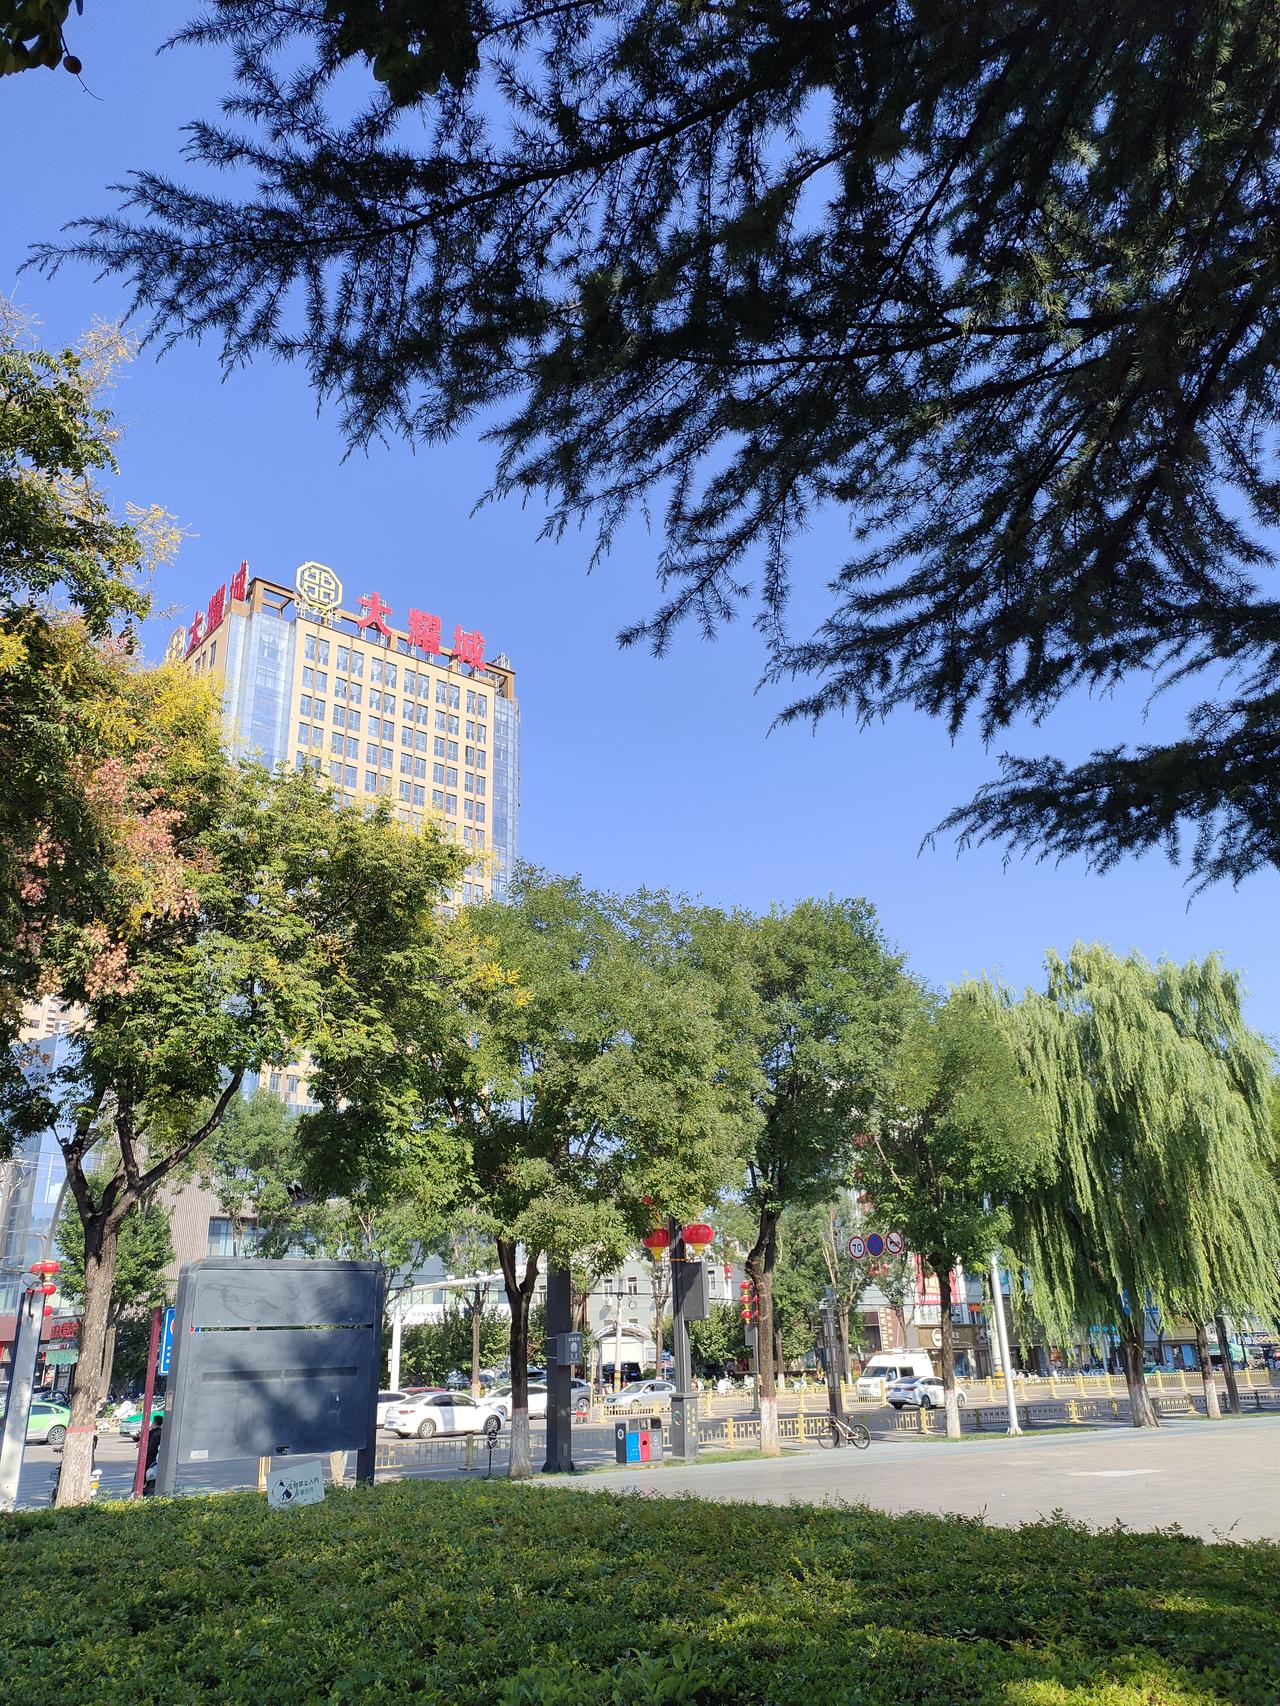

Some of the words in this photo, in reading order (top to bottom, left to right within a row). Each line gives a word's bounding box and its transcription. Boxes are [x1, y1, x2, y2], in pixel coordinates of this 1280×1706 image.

[357, 592, 486, 671] 大耀城
[852, 1243, 863, 1253] 70
